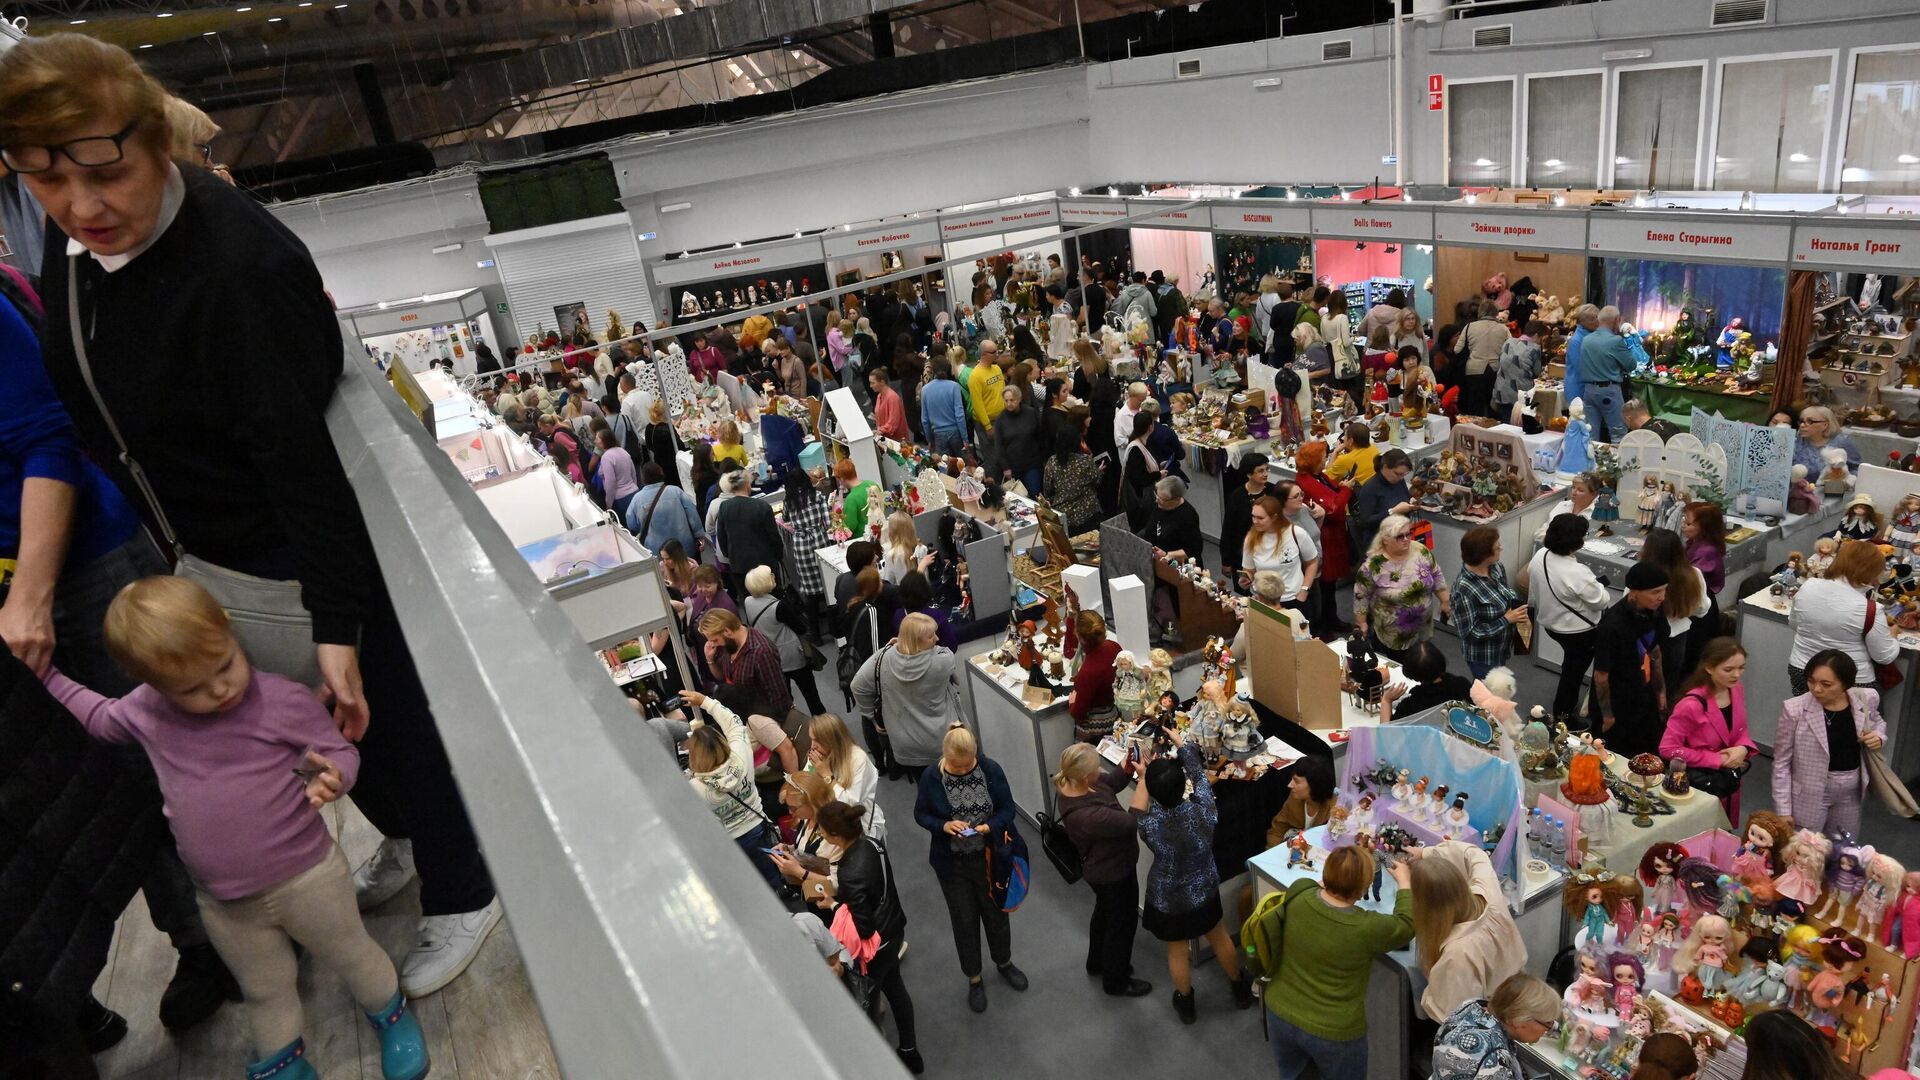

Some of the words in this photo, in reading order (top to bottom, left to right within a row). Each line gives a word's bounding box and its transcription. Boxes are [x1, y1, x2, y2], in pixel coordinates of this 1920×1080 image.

[1354, 218, 1369, 228] Dolls
[1370, 218, 1392, 229] flowers
[1646, 230, 1675, 241] Елена
[1679, 231, 1733, 246] Старыгина
[1811, 238, 1860, 252] Наталья
[1865, 239, 1901, 255] Грант
